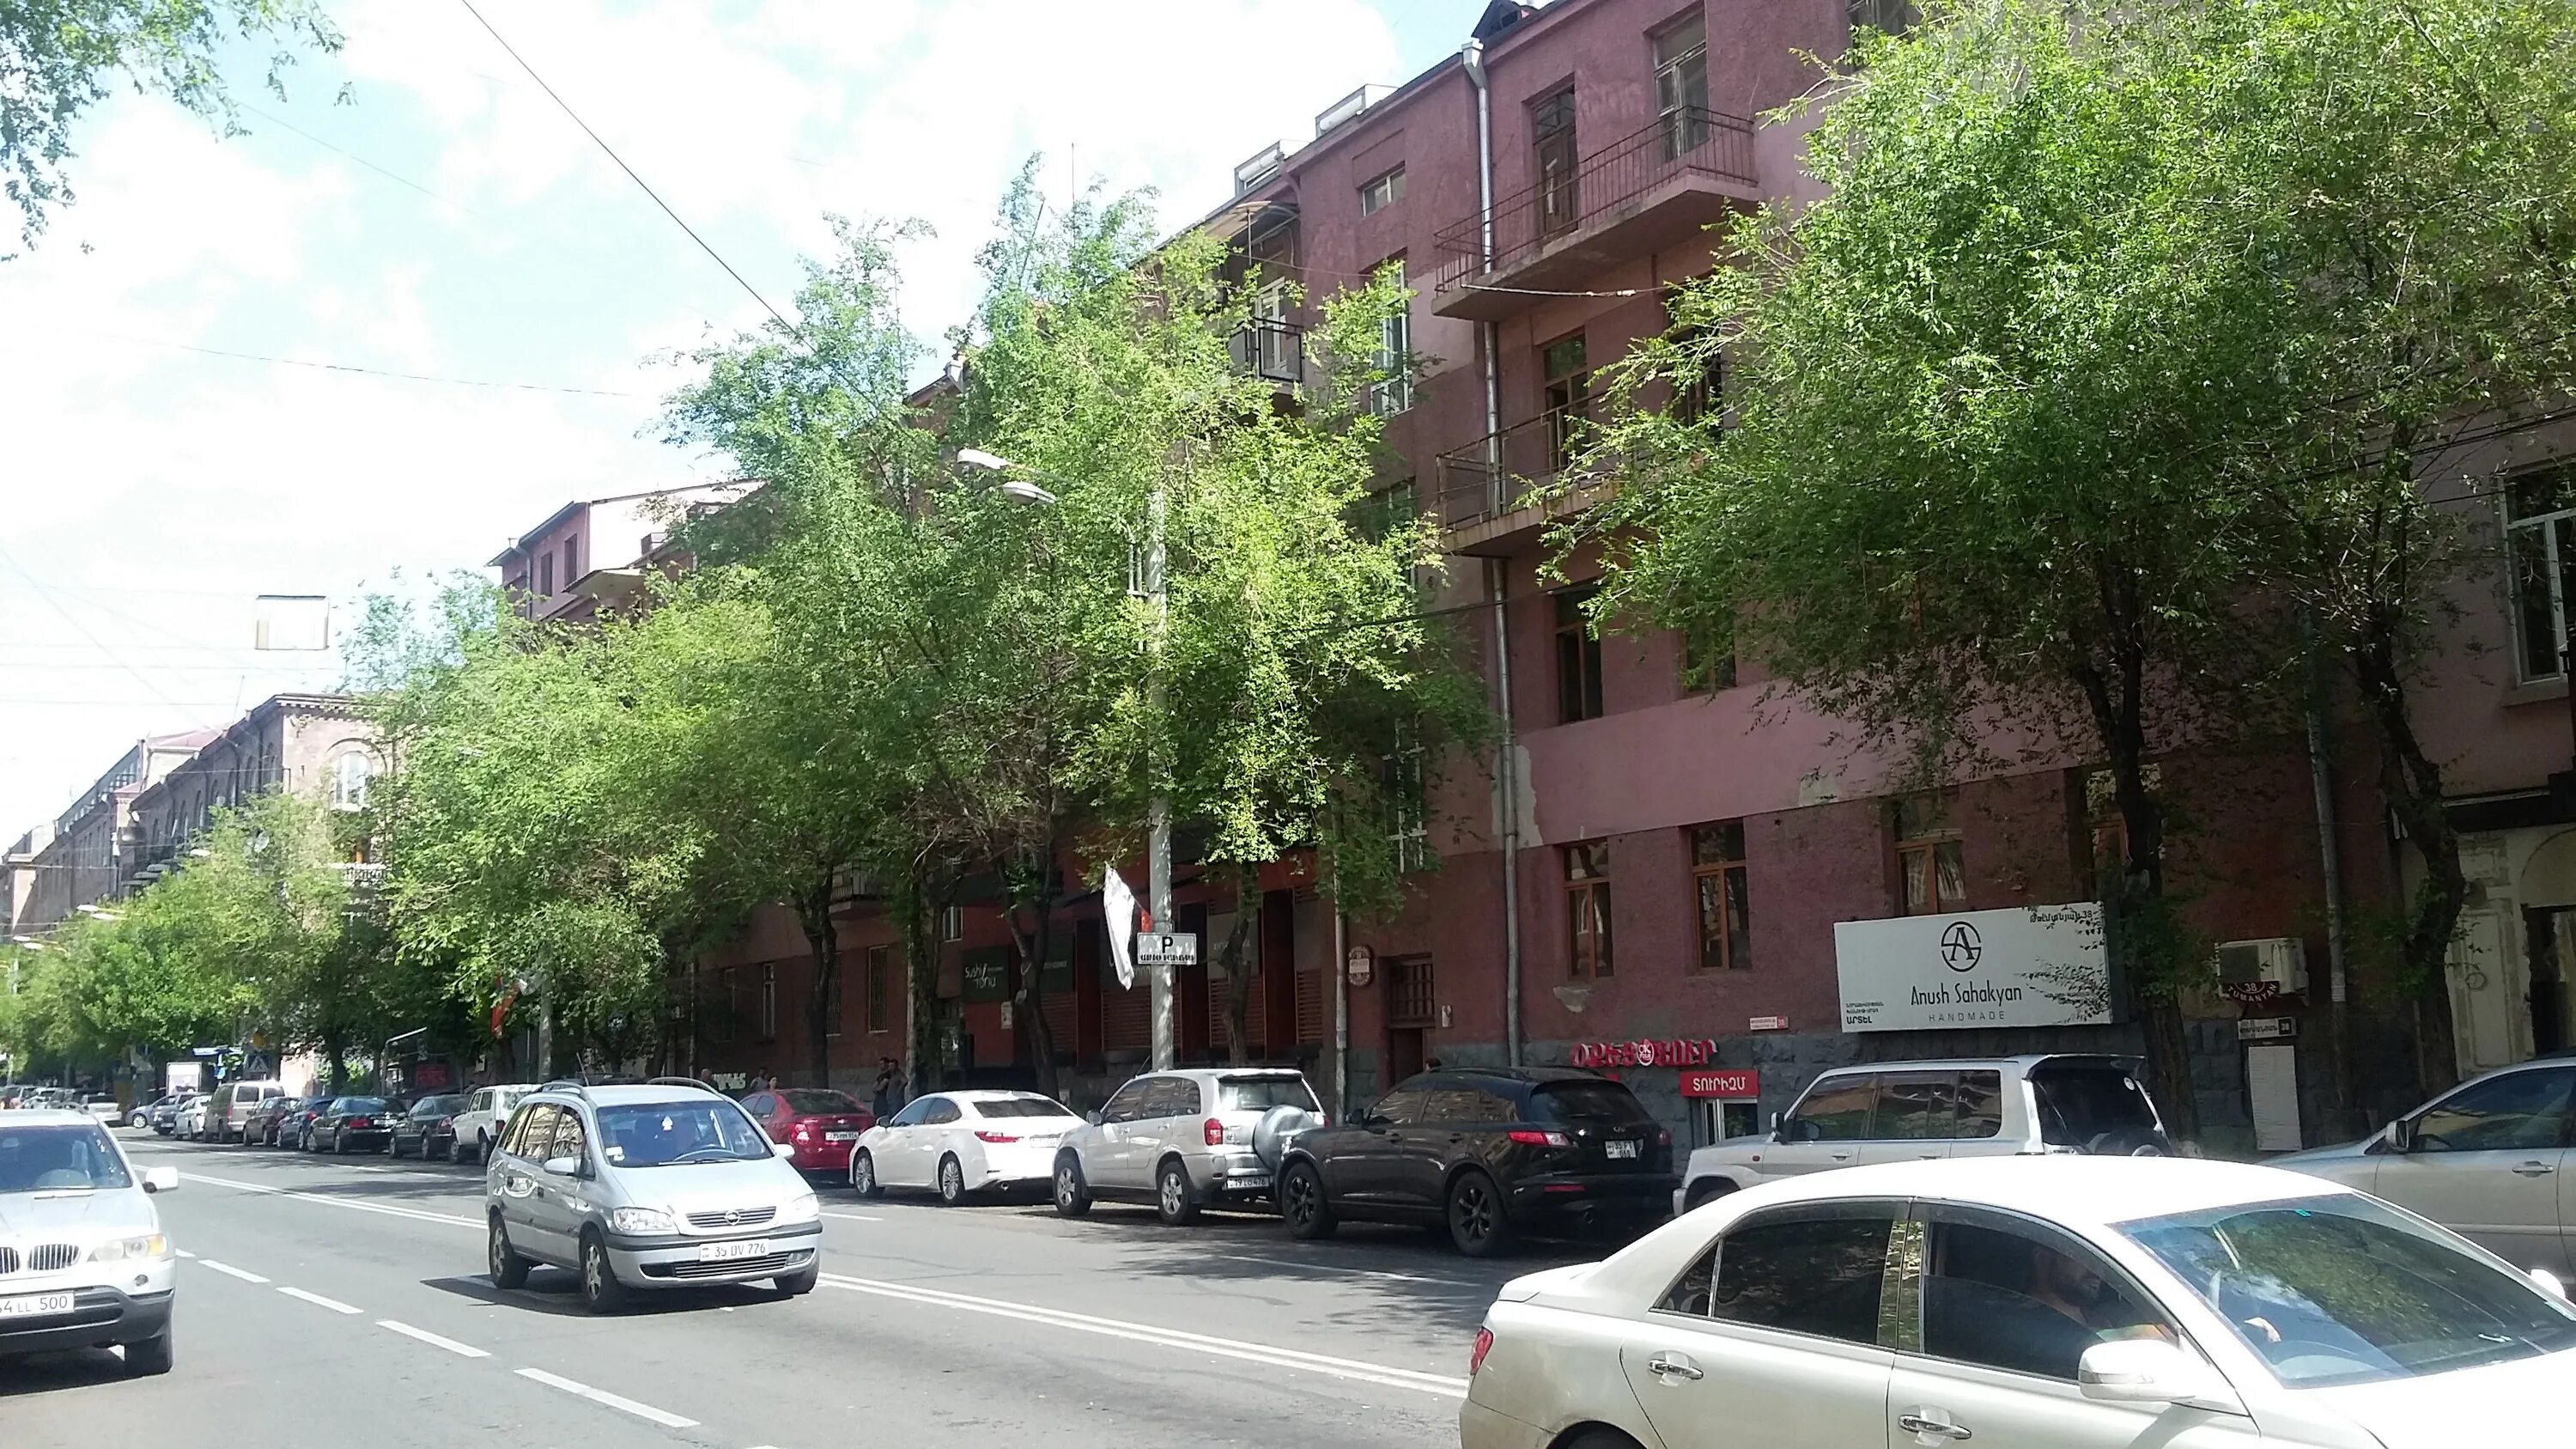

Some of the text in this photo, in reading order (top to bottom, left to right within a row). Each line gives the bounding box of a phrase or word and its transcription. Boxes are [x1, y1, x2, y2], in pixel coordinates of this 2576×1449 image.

[1162, 935, 1174, 953] P
[1911, 980, 2022, 1007] Anush Sahakyan
[2228, 983, 2277, 1002] TUMANYAN
[2245, 983, 2257, 992] 38
[1929, 1011, 2005, 1022] HANDMADE
[715, 1246, 727, 1257] 35
[748, 1243, 766, 1255] 776
[18, 1301, 32, 1312] LL
[39, 1295, 68, 1311] 500
